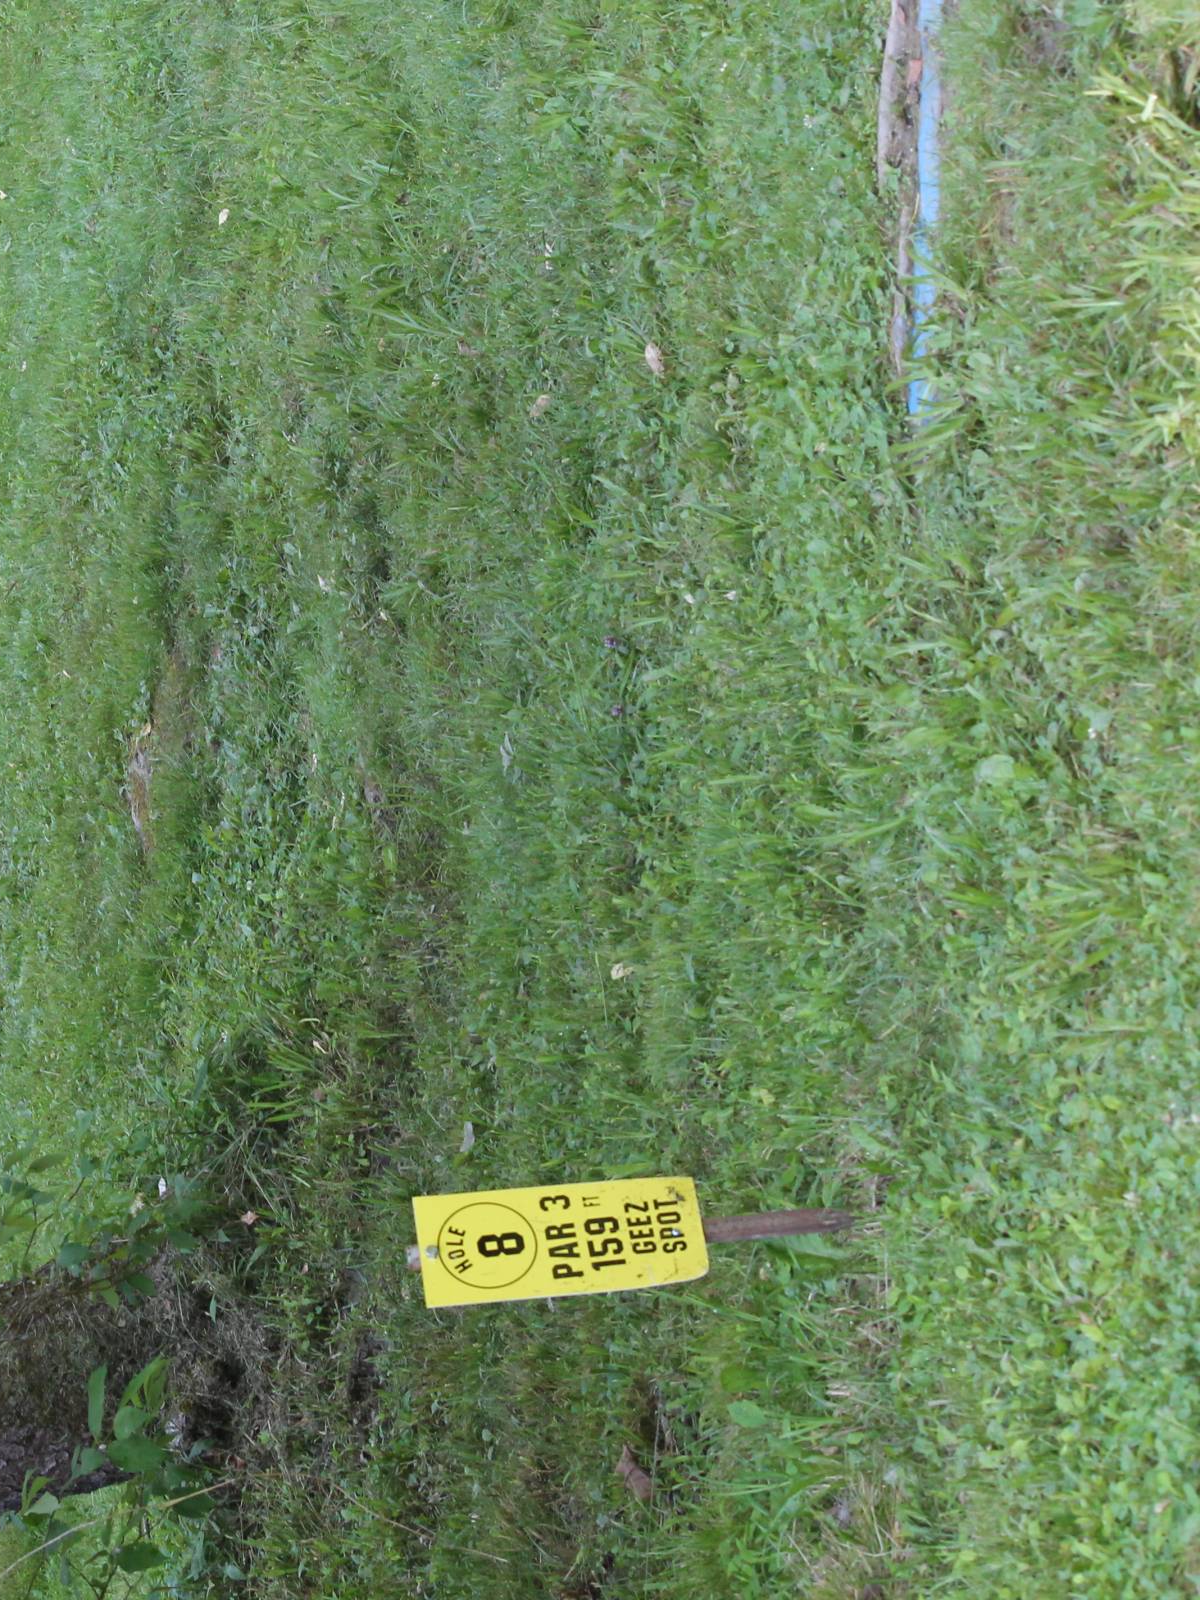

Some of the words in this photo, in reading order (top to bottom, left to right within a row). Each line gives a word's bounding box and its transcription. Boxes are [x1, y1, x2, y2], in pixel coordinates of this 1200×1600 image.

[539, 1194, 570, 1211] 3
[582, 1196, 601, 1207] FT
[653, 1199, 687, 1253] SPOT
[447, 1226, 473, 1274] HOLE
[477, 1231, 525, 1258] 8
[544, 1223, 584, 1279] PAR
[584, 1216, 626, 1271] 159
[624, 1201, 657, 1255] GEEZ
